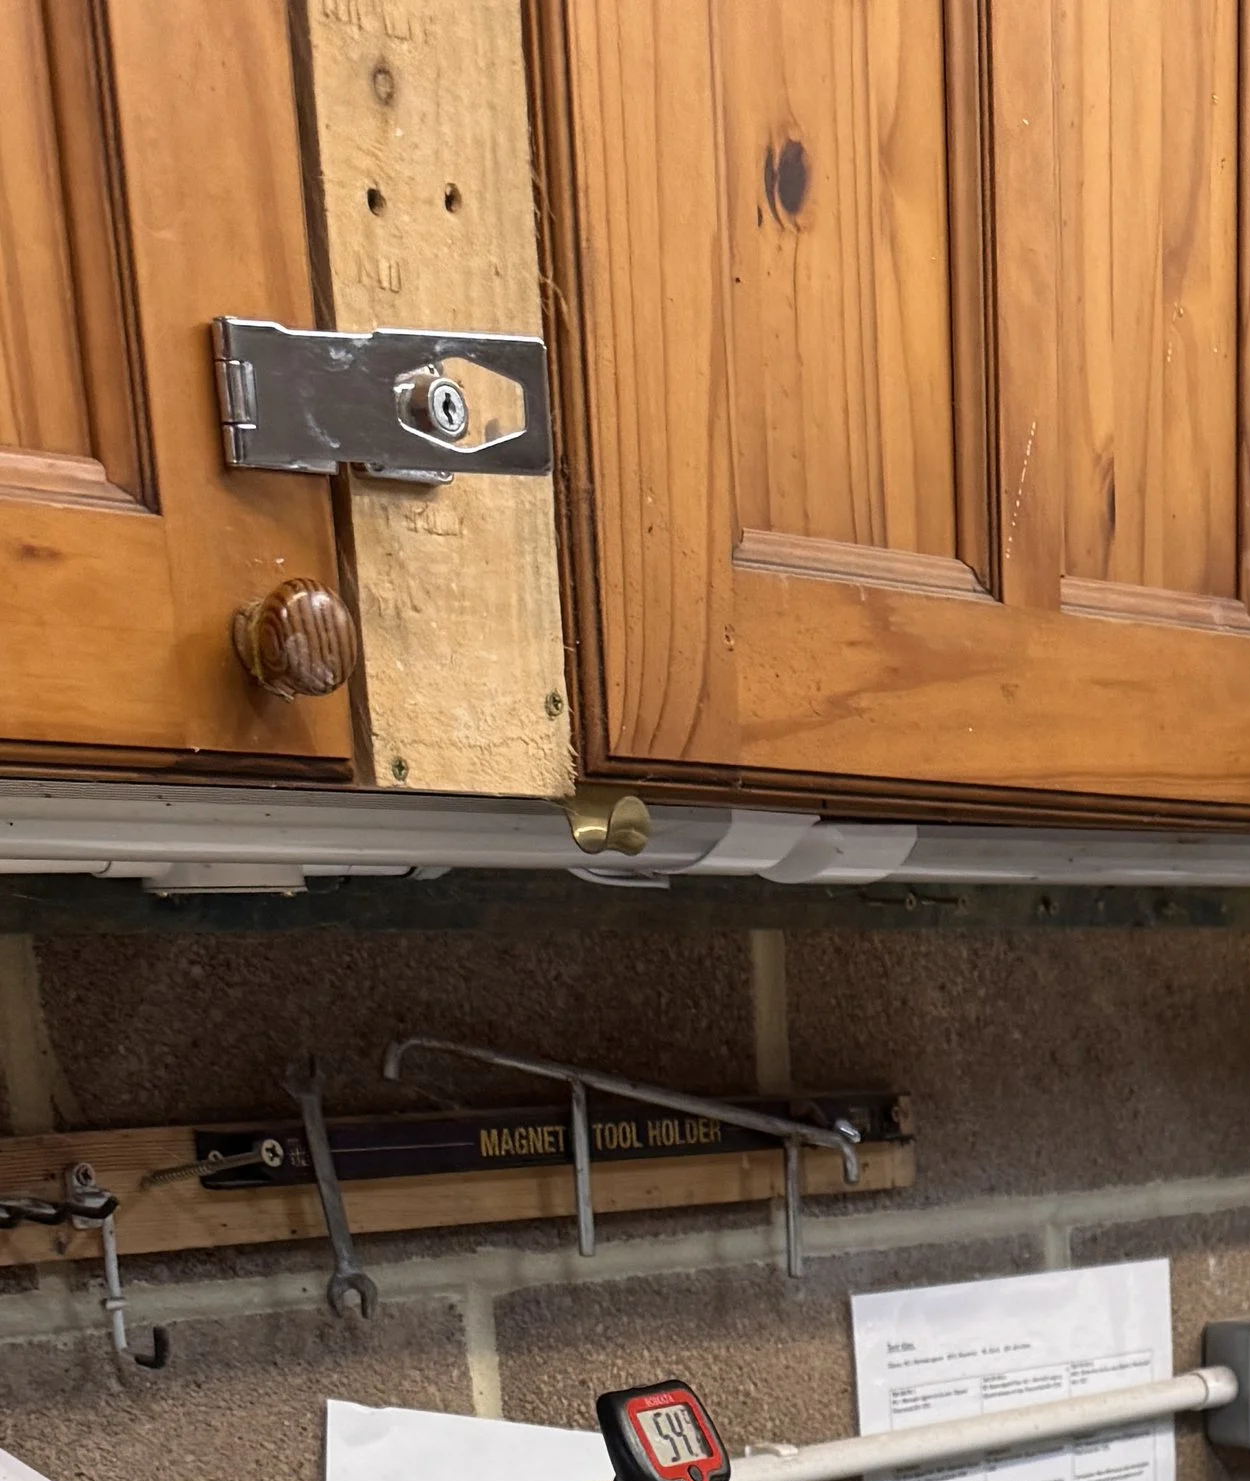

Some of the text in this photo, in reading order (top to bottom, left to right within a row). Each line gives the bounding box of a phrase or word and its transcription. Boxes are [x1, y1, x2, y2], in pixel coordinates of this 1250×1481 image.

[480, 1118, 722, 1157] MAGNET TOOL HOLDER
